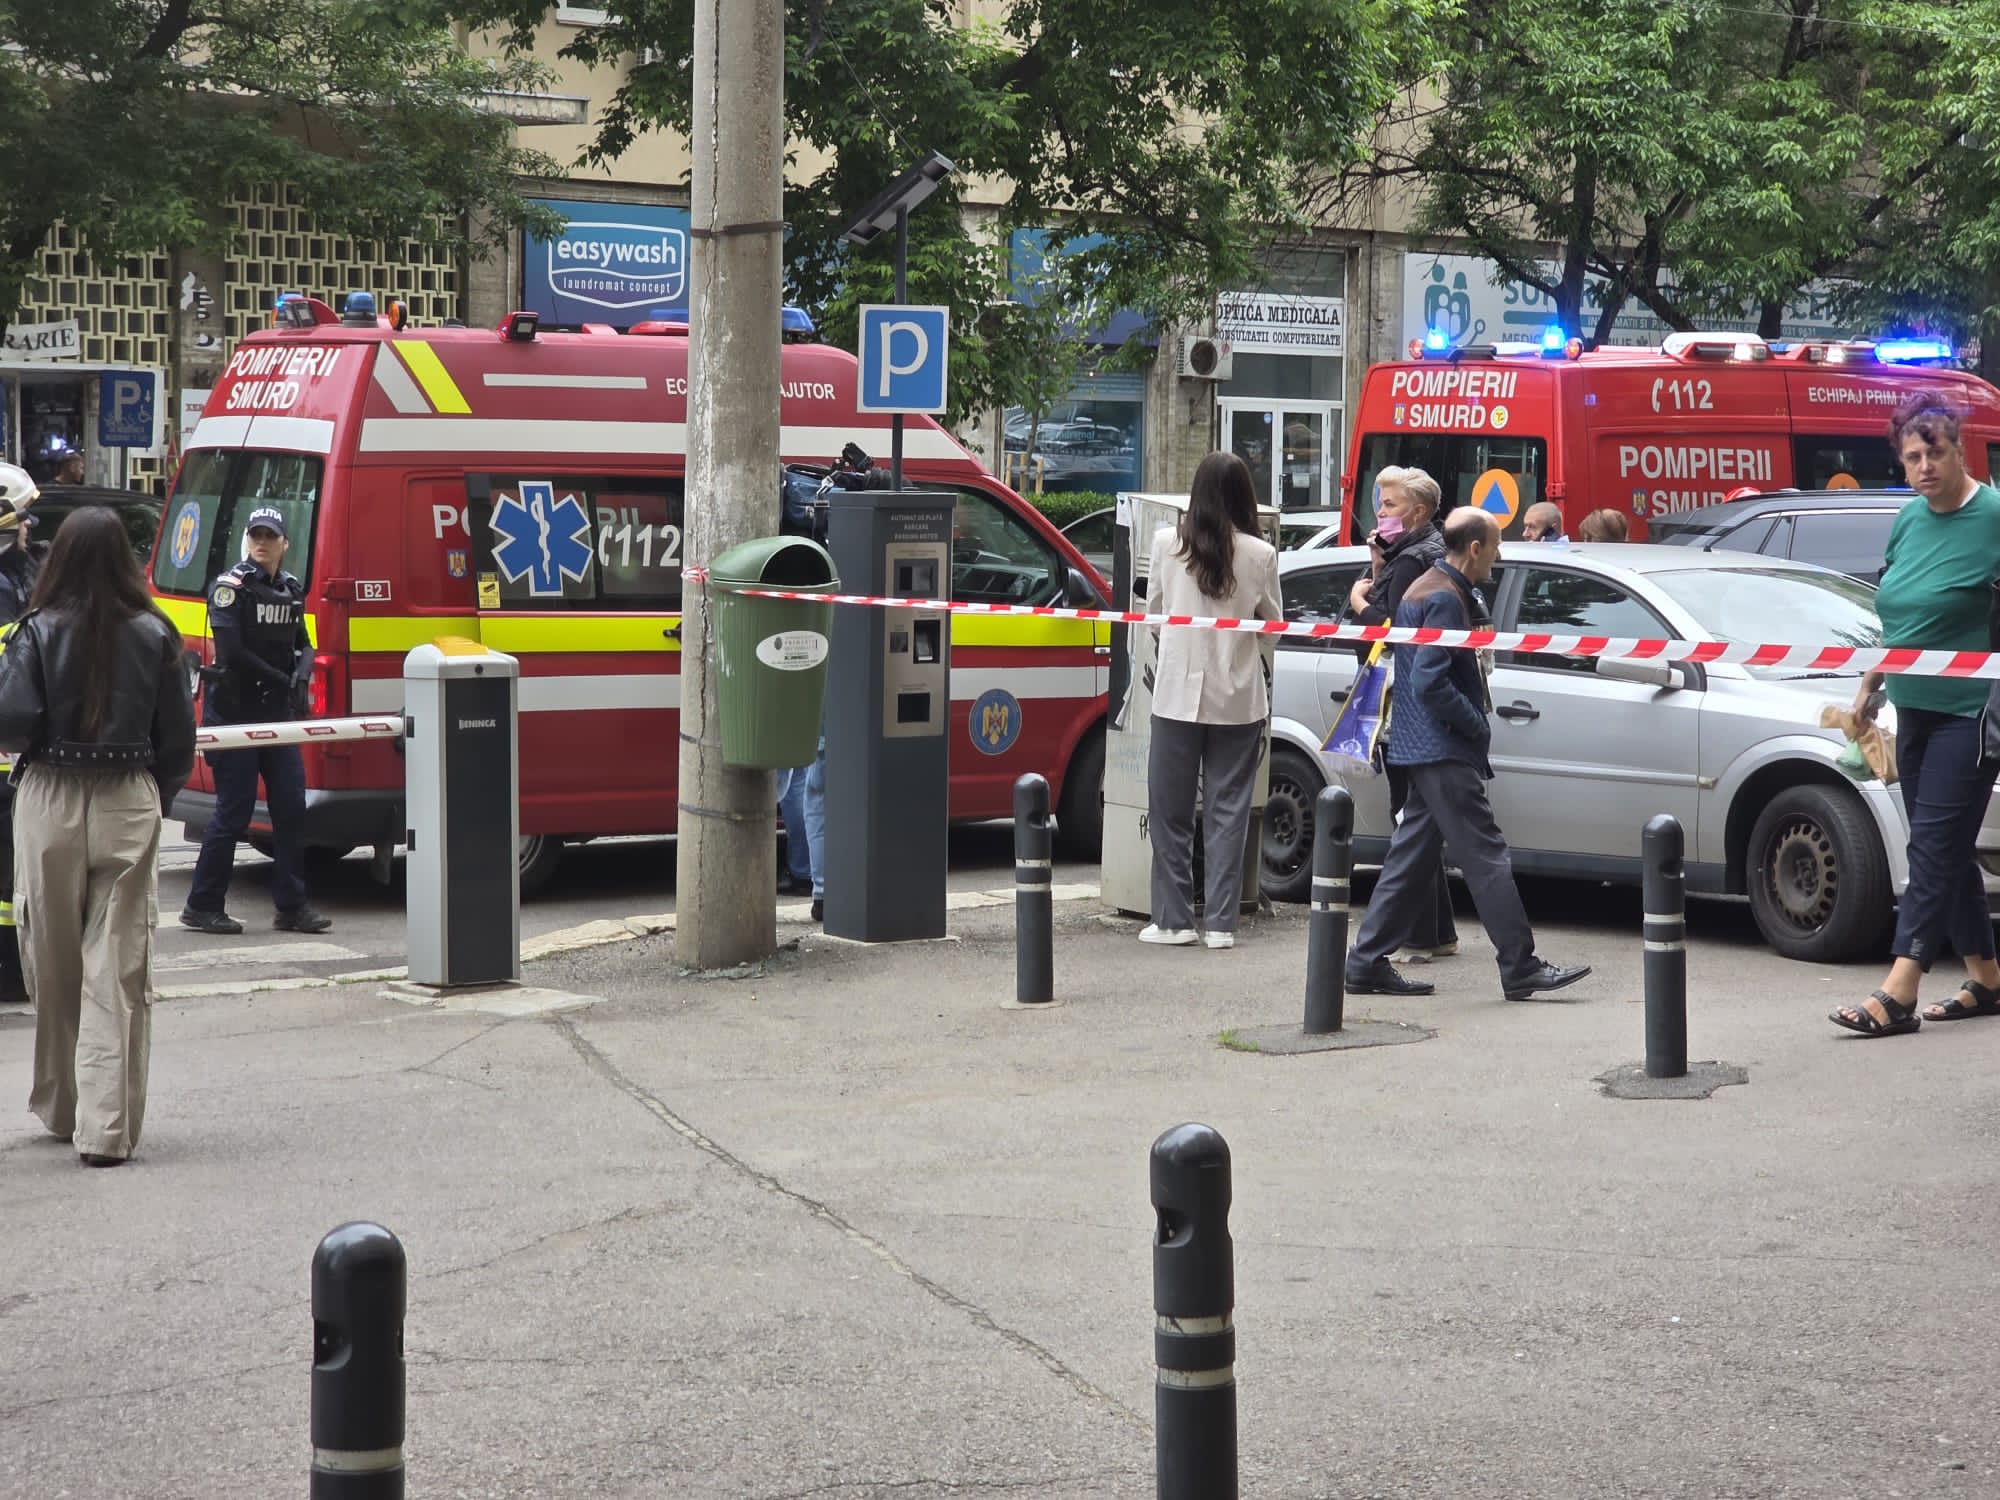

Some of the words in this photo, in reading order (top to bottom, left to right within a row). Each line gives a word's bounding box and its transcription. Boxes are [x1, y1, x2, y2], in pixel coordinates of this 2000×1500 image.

[557, 237, 677, 268] easywash
[563, 276, 625, 292] laundromat
[629, 281, 671, 295] concept
[1267, 306, 1341, 326] MEDICALA
[1272, 331, 1341, 346] COMPUTERIZATE
[224, 346, 342, 379] POMPIERII
[879, 321, 929, 397] P
[226, 381, 299, 410] SMURD
[778, 383, 835, 400] AJUTOR
[1391, 370, 1518, 399] POMPIERII
[1668, 379, 1714, 409] 112
[1808, 386, 1863, 405] ECHIPAJ
[1865, 389, 1897, 406] PRIM
[114, 380, 142, 422] P
[1408, 403, 1487, 429] SMURD
[1619, 446, 1772, 481] POMPIERII
[615, 523, 681, 568] 112
[363, 583, 383, 599] B2
